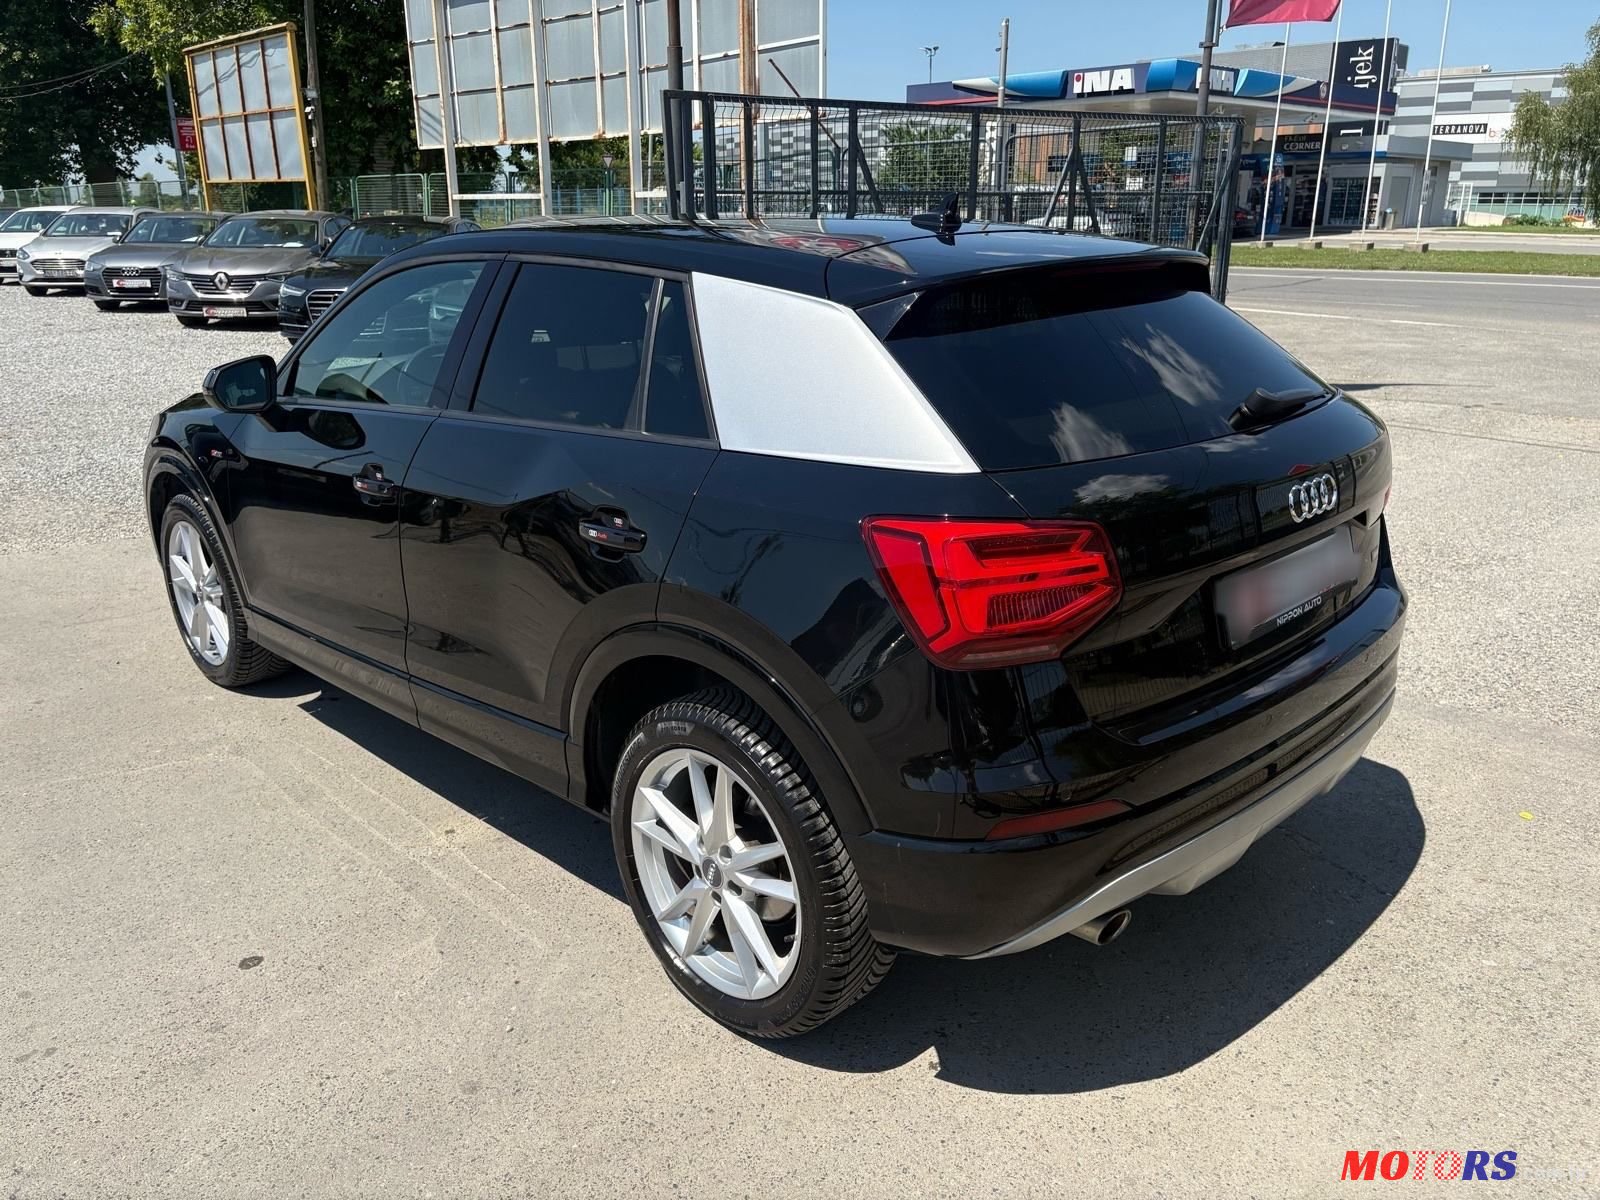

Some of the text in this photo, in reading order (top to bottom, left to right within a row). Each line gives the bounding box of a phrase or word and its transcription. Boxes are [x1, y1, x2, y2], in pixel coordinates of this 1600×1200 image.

[1434, 124, 1485, 134] TERRANOVA
[1283, 141, 1321, 151] CORNER
[1276, 596, 1322, 627] NIPPON AUTO
